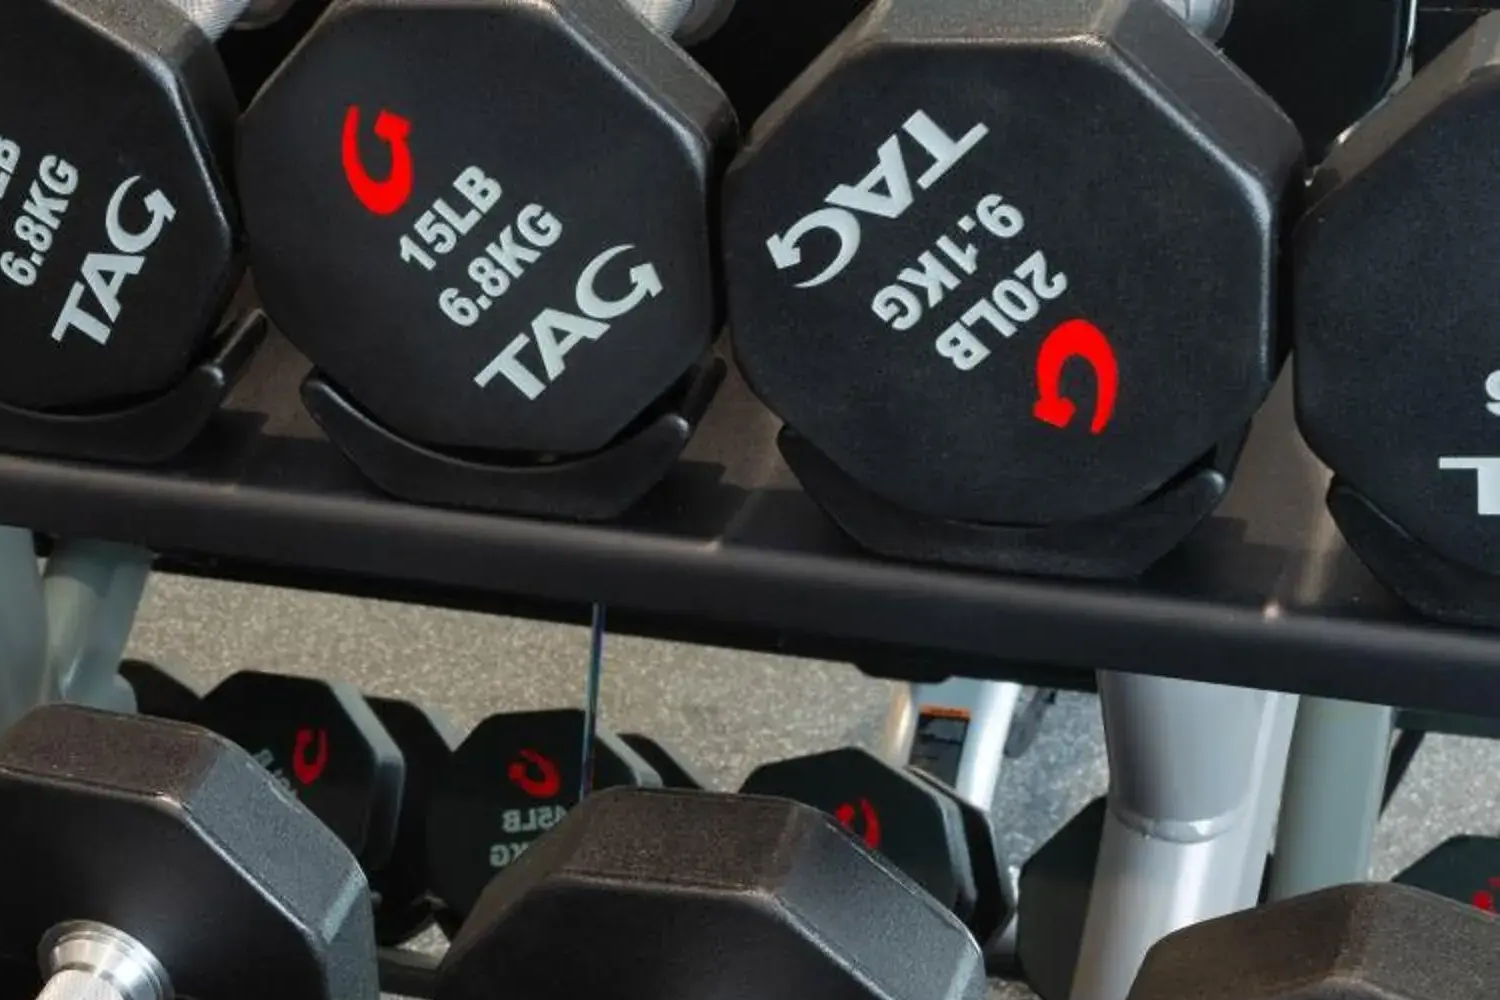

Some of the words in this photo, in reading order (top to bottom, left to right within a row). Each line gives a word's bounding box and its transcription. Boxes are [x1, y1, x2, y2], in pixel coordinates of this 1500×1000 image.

[0, 154, 79, 287] 6.8KG
[51, 175, 177, 345] TAG
[399, 165, 503, 272] 15LB
[438, 203, 563, 328] 6.8KG
[765, 109, 989, 288] TAG
[871, 193, 1025, 331] 9.1KG
[473, 244, 664, 401] TAG
[935, 249, 1068, 371] 20LB
